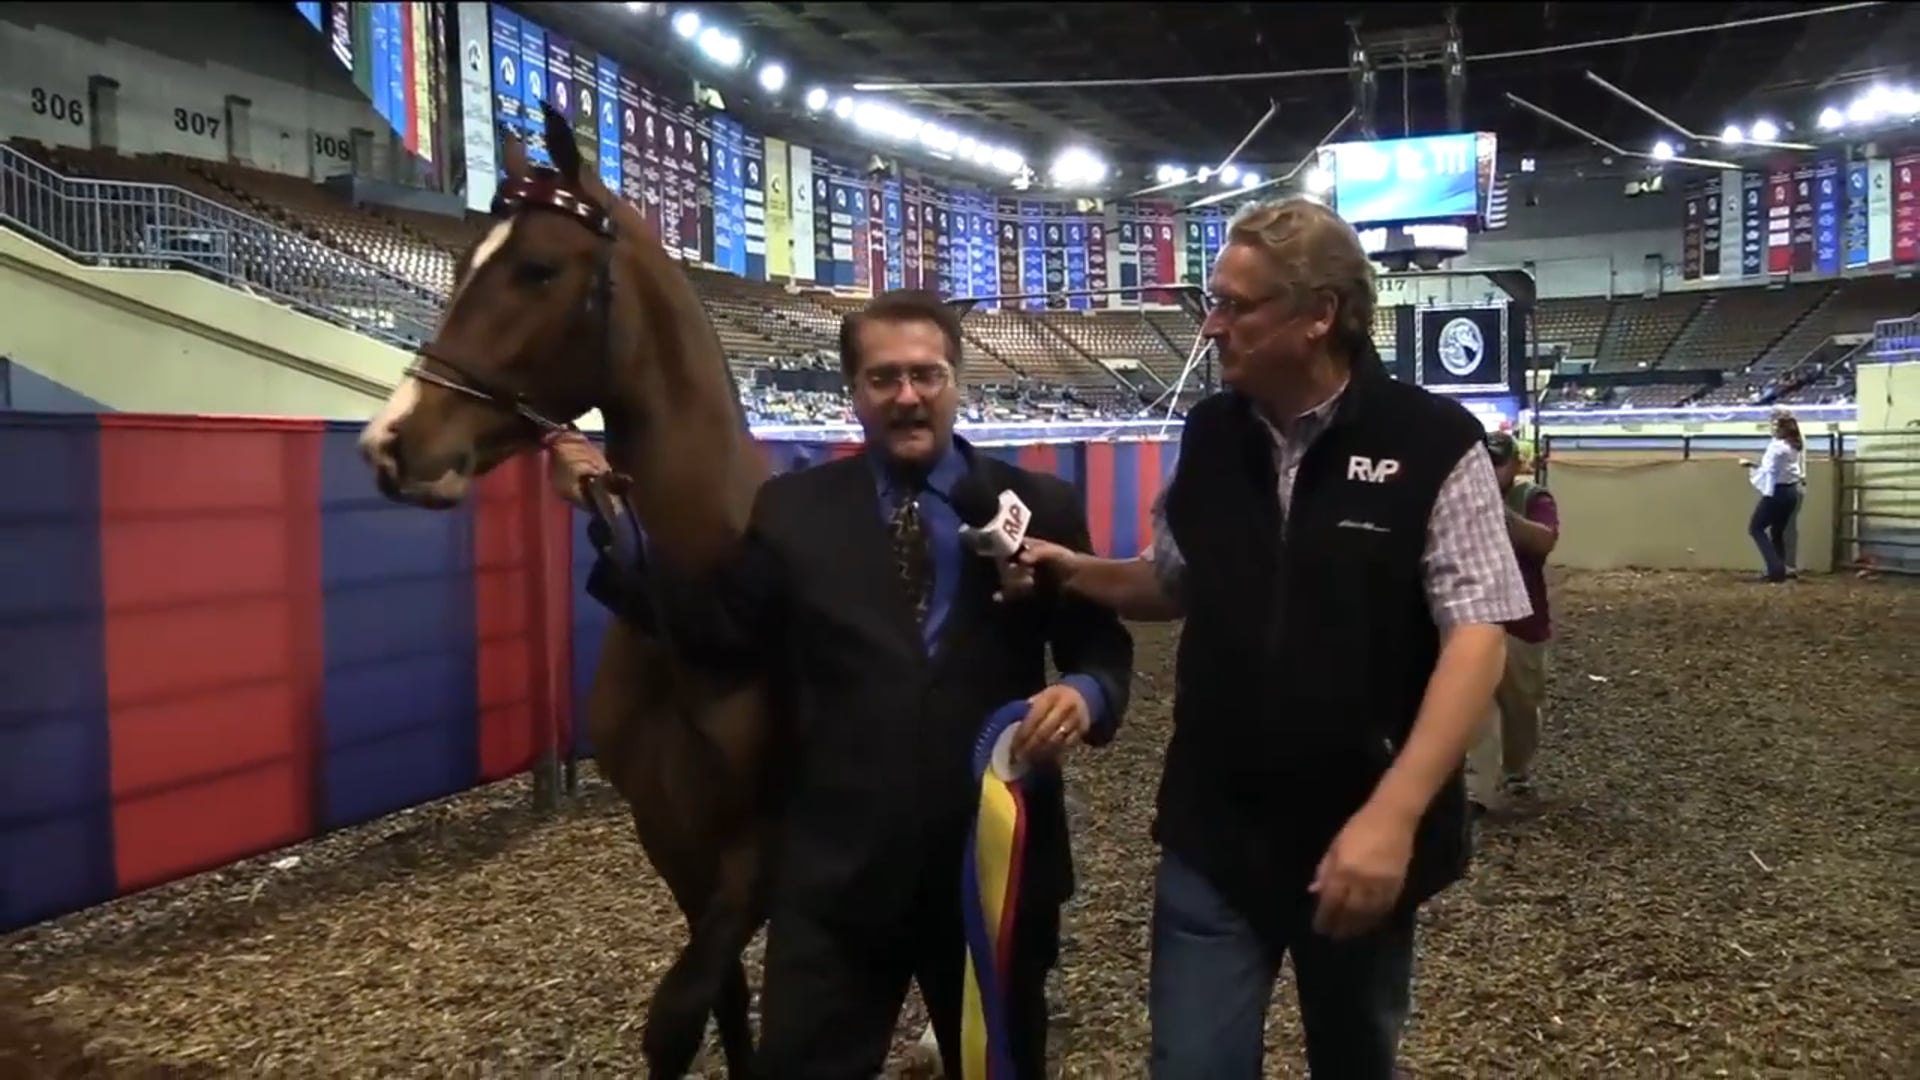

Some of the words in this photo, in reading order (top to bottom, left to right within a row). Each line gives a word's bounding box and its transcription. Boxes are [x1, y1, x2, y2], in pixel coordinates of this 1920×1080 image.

[31, 87, 84, 126] 306
[174, 108, 220, 139] 307
[1347, 455, 1400, 483] RVP
[1002, 503, 1023, 542] RVP
